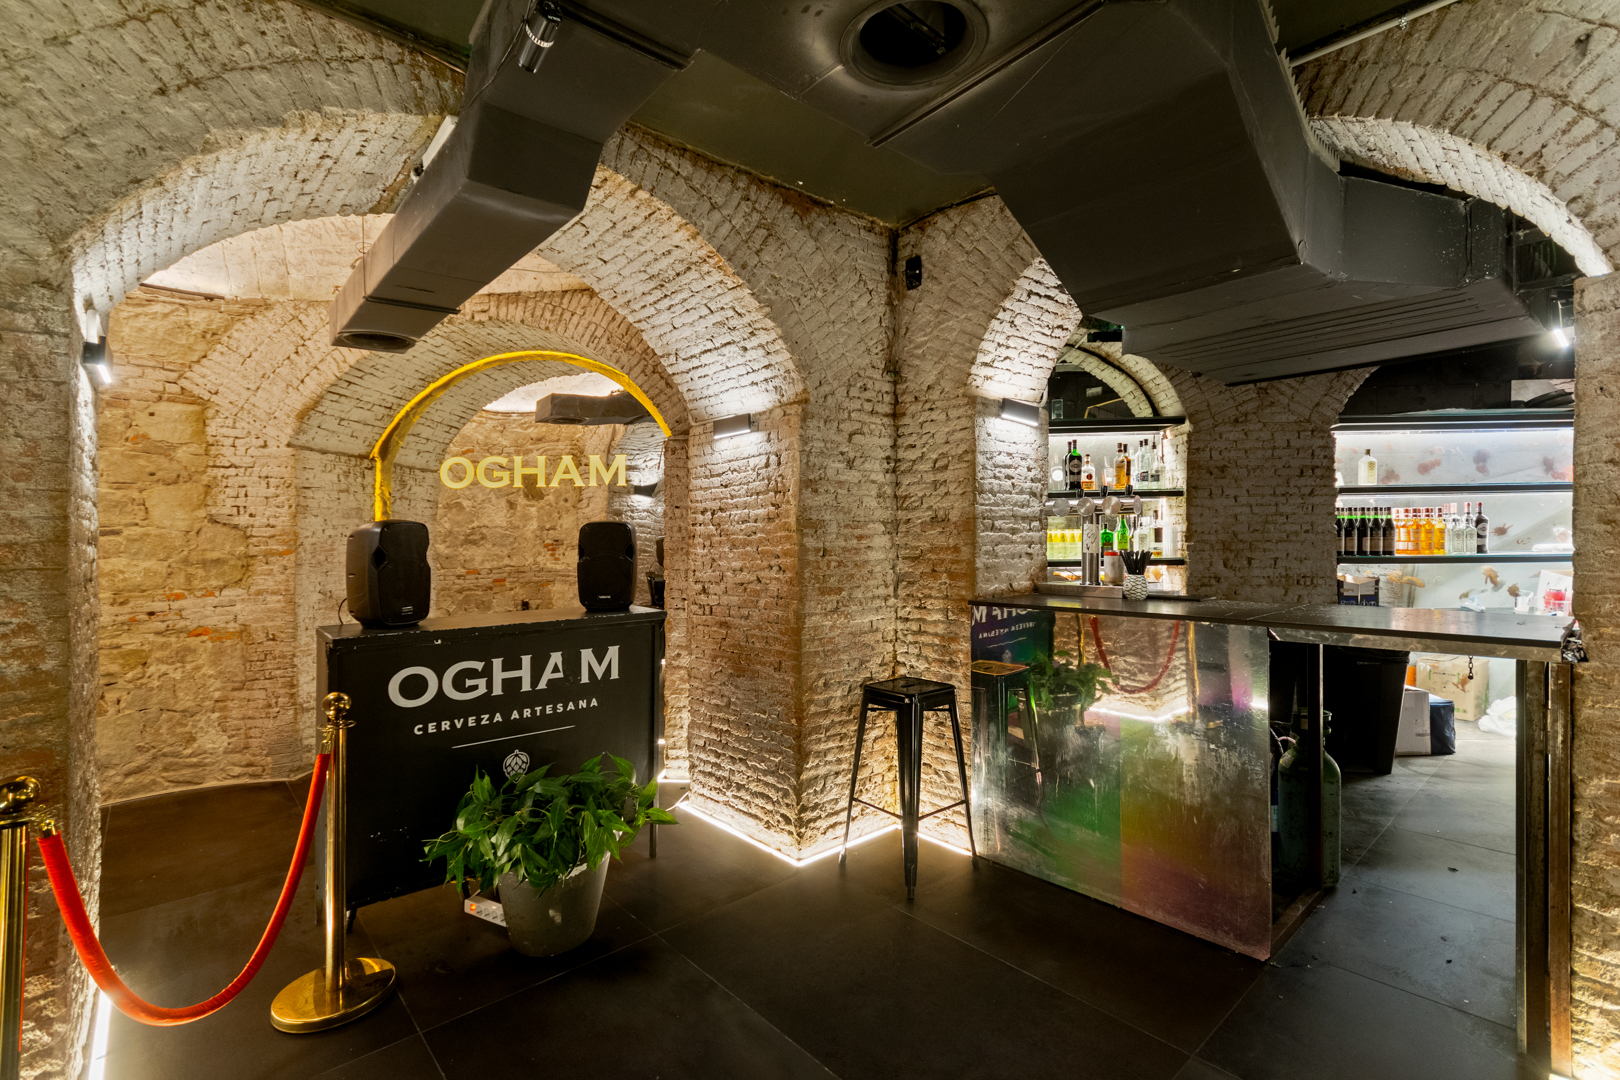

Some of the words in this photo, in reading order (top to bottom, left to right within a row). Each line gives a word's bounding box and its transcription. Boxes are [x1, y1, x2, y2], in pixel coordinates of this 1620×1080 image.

[439, 454, 628, 489] OGHAM
[387, 645, 620, 708] OGHAM
[413, 713, 503, 735] CERVEZA
[511, 698, 599, 720] ARTESANA
